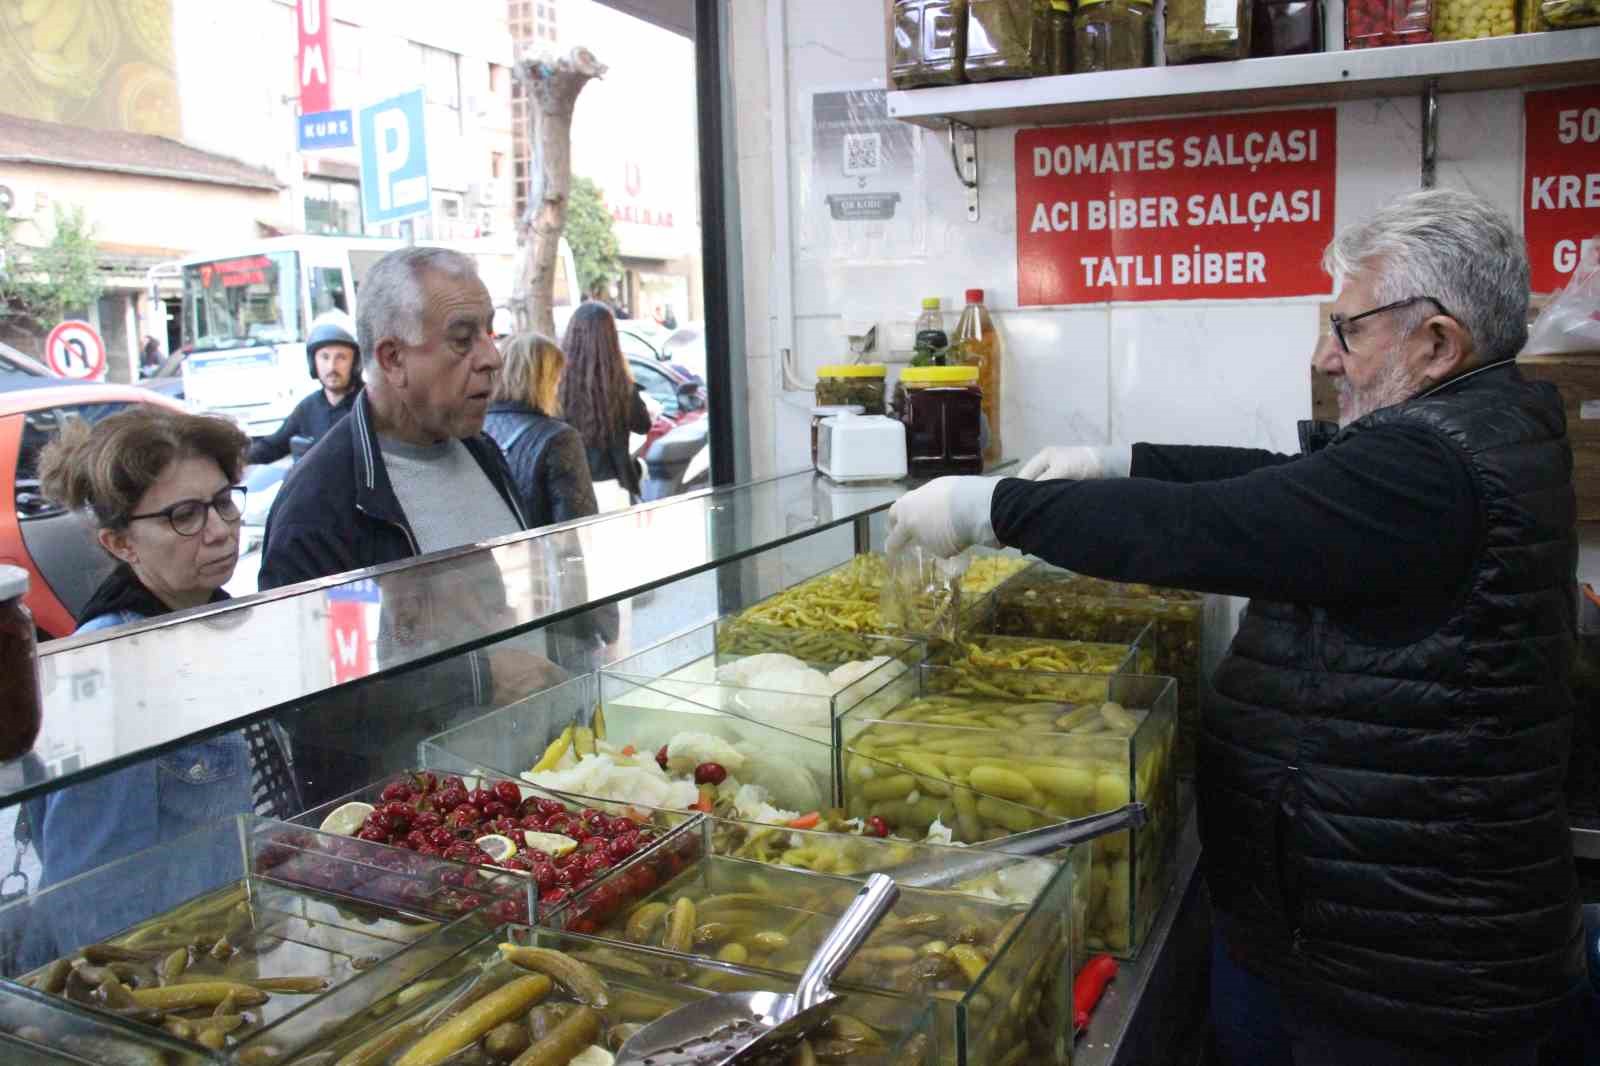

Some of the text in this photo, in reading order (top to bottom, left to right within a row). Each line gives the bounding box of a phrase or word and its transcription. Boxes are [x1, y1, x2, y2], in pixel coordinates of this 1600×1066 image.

[304, 119, 349, 139] KURS
[374, 107, 411, 212] P
[1033, 128, 1318, 177] DOMATES SALÇASI
[1030, 189, 1321, 233] ACI BİBER SALÇASI
[1080, 244, 1267, 288] TATLI BİBER
